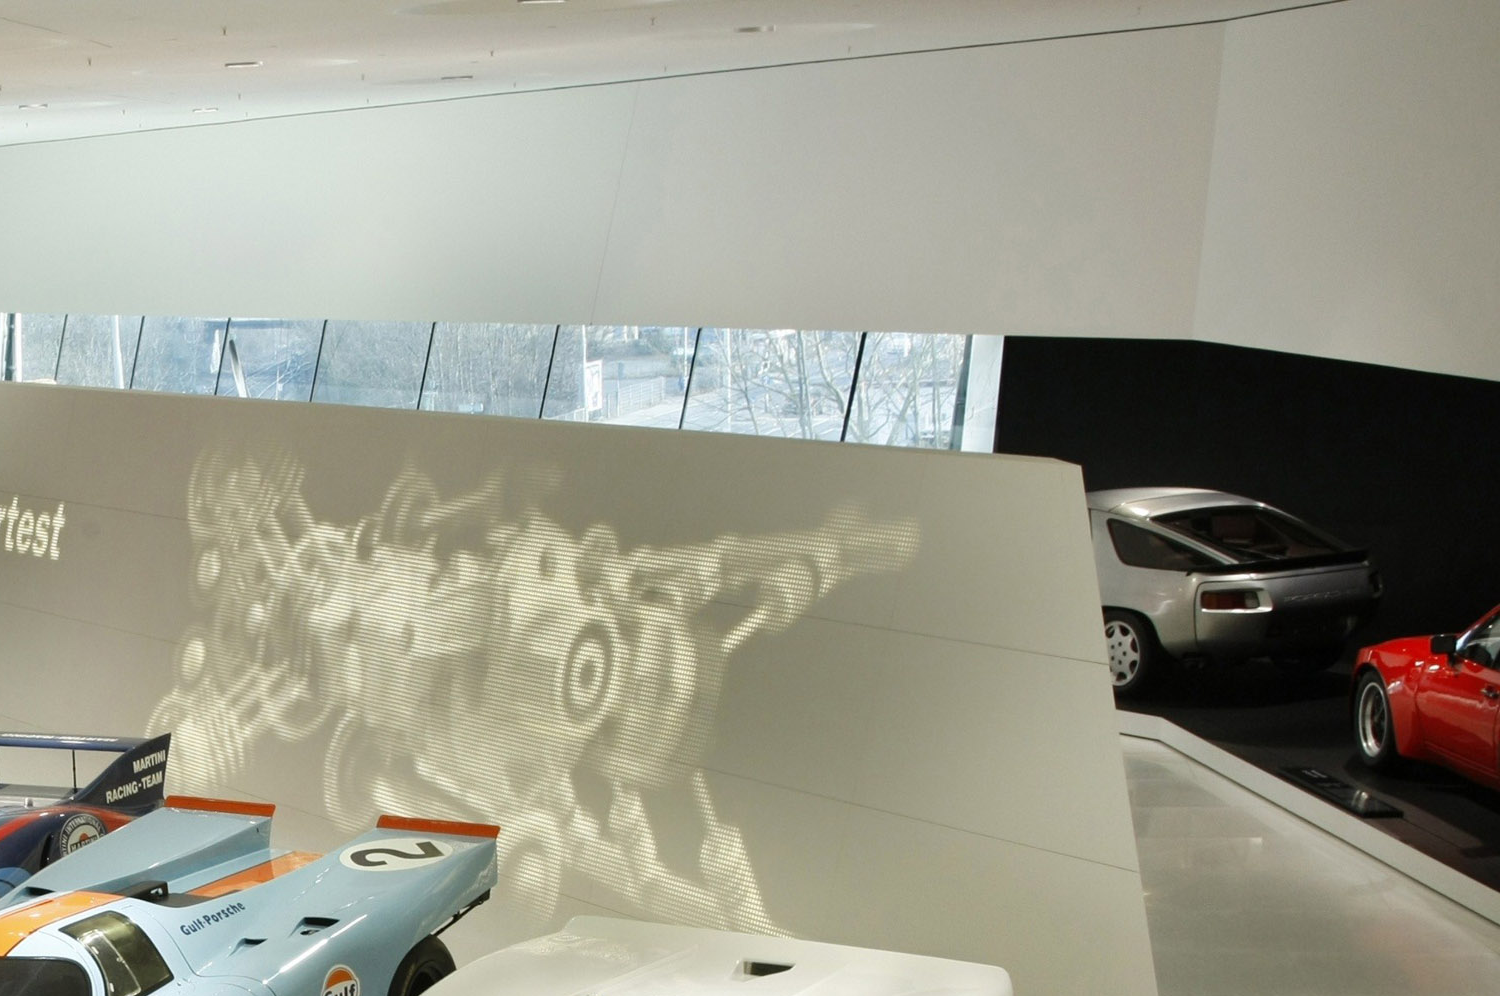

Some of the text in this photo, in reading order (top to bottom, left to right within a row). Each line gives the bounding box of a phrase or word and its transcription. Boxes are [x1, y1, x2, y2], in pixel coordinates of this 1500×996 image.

[133, 750, 167, 774] MARTINI
[105, 771, 163, 804] RACING-TEAM
[350, 841, 446, 867] 2
